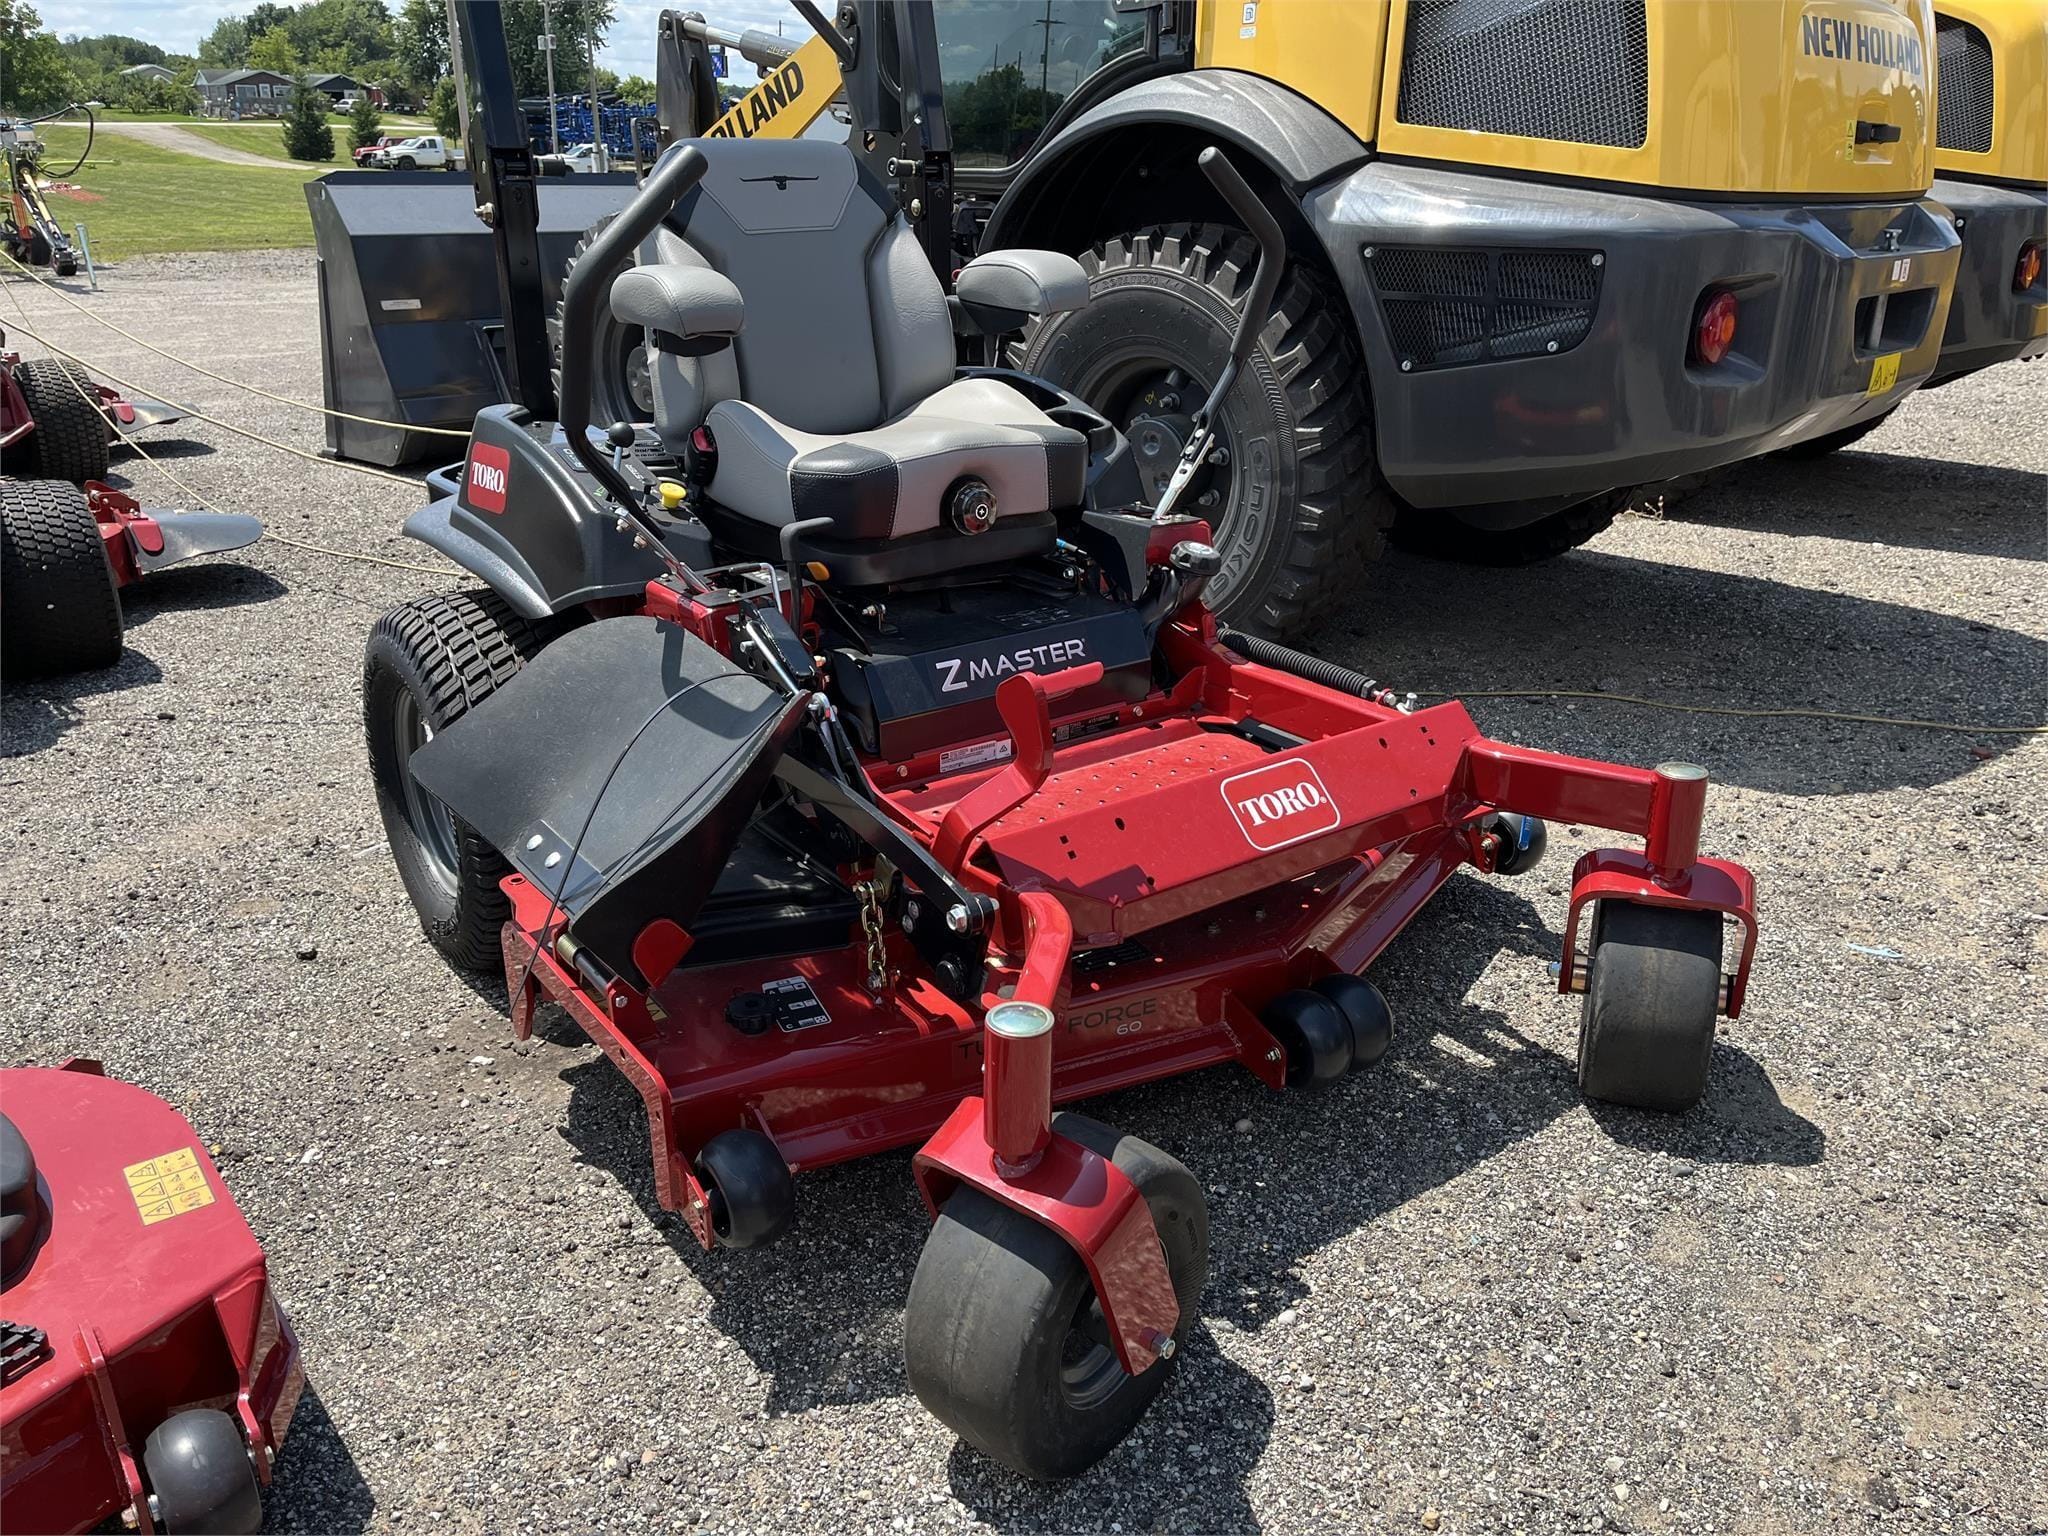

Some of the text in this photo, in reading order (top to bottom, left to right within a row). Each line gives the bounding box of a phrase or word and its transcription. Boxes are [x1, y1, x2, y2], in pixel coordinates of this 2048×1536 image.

[1803, 15, 1921, 75] NEW HOLLAND
[1068, 998, 1158, 1035] FORCE
[1117, 1020, 1142, 1035] 60
